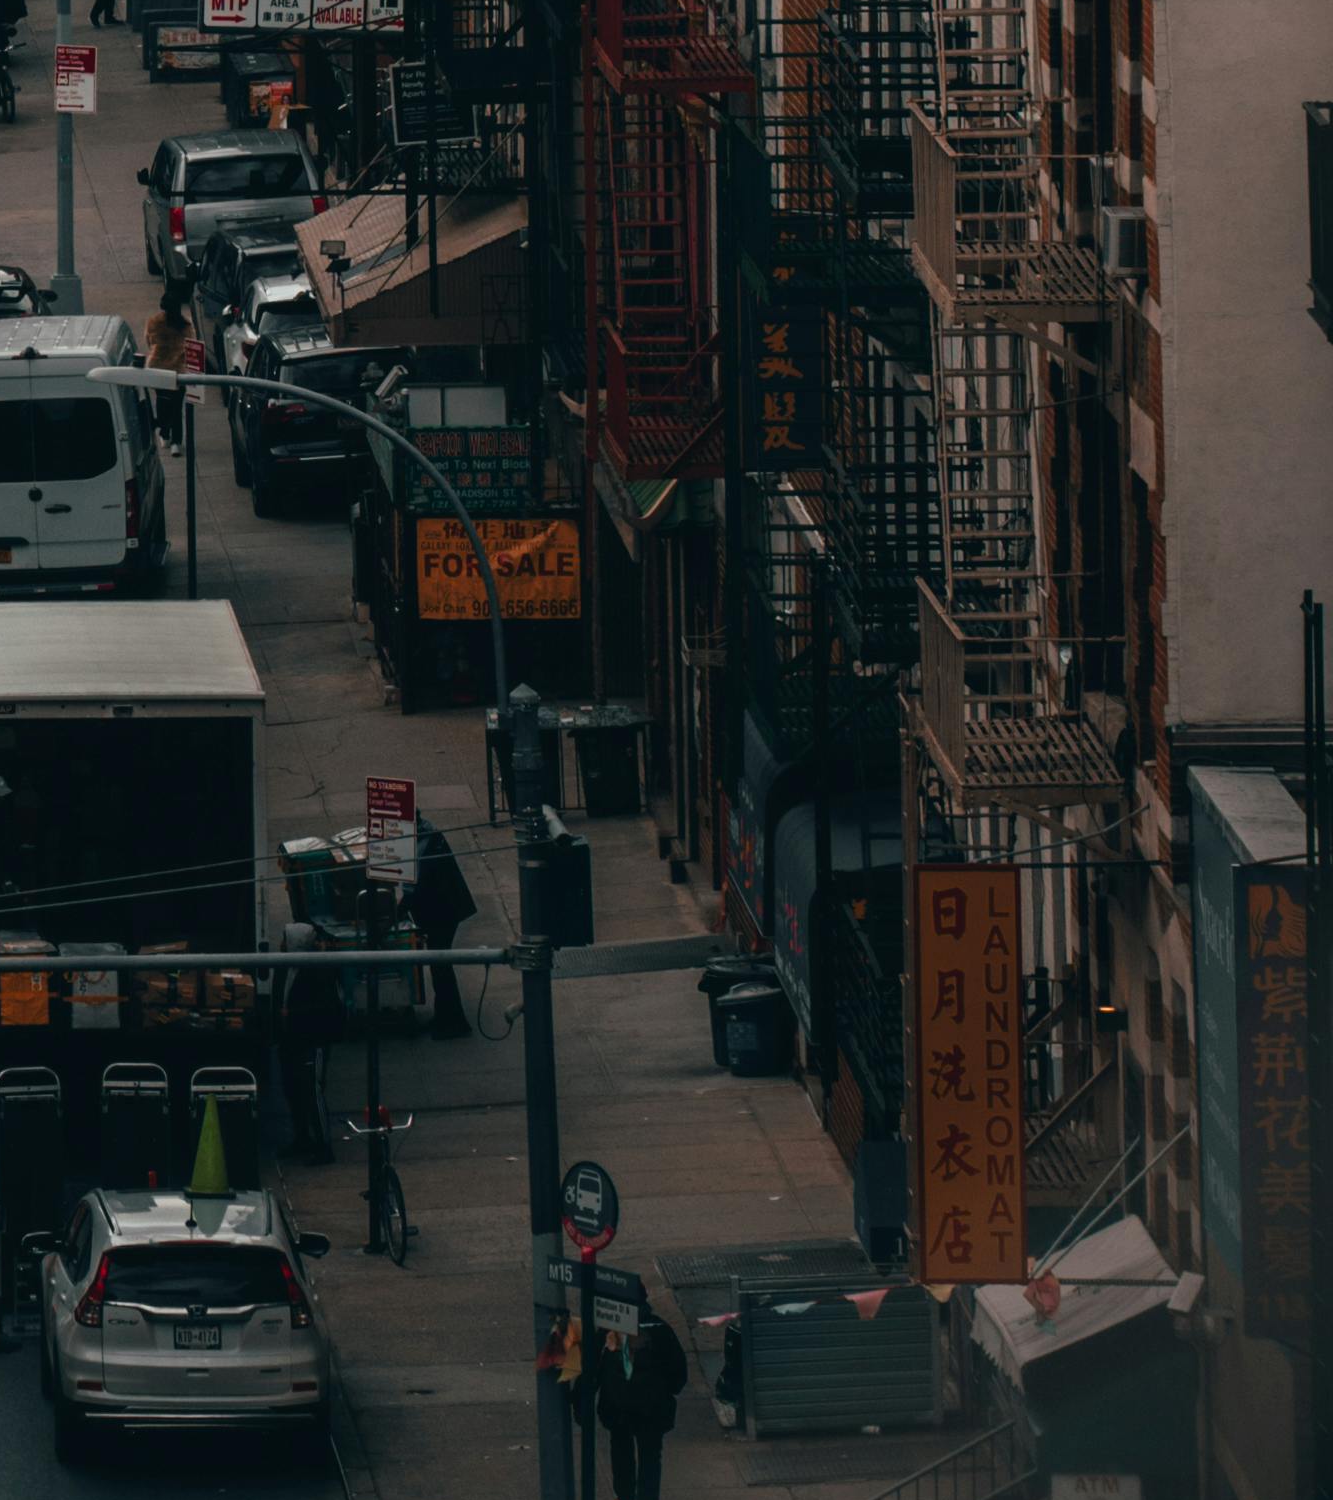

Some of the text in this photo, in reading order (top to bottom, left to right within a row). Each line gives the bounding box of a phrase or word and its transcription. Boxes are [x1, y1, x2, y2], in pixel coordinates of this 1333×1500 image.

[315, 7, 362, 24] AVAILABLE
[414, 431, 531, 456] SEAFOOD WHOLESALE
[453, 458, 531, 469] To Next Block
[424, 551, 574, 577] FOR SALE
[472, 598, 578, 617] 90-656-6666
[928, 886, 981, 1265] 日月洗衣店
[983, 886, 1016, 1263] LAUNDROMAT
[548, 1262, 573, 1283] M15
[1075, 1476, 1120, 1494] ATM
